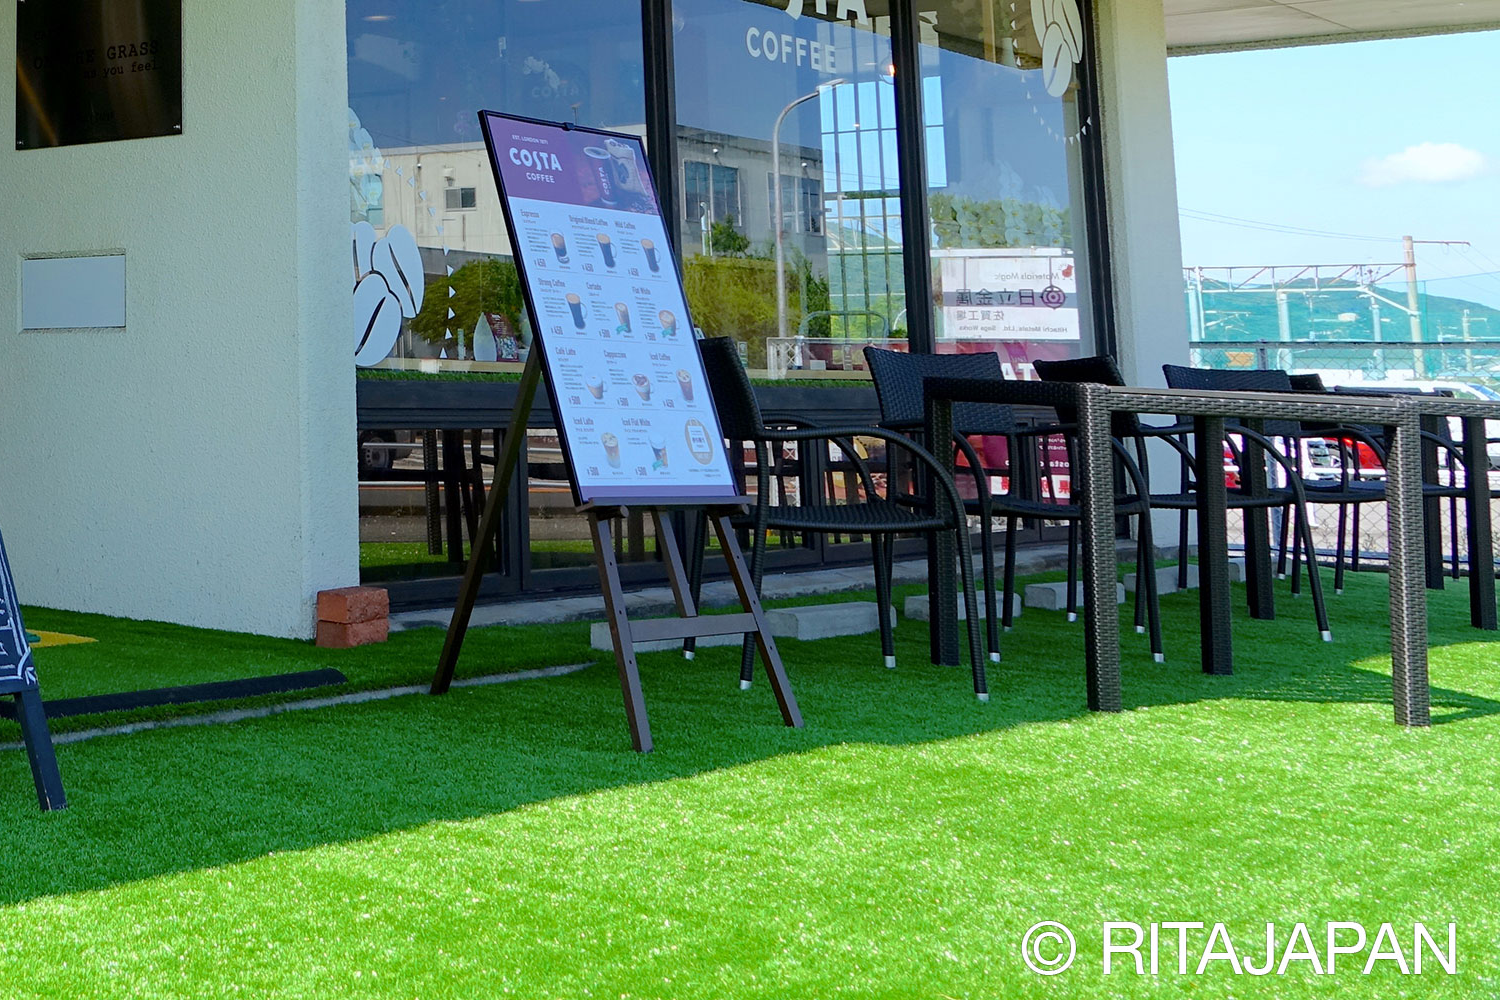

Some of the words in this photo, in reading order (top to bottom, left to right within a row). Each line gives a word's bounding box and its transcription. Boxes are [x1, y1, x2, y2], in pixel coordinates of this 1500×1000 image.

[106, 40, 160, 61] GRASS
[746, 26, 837, 75] COFFEE
[103, 64, 124, 79] you
[509, 146, 563, 172] COSTA
[526, 172, 555, 183] COFFEE
